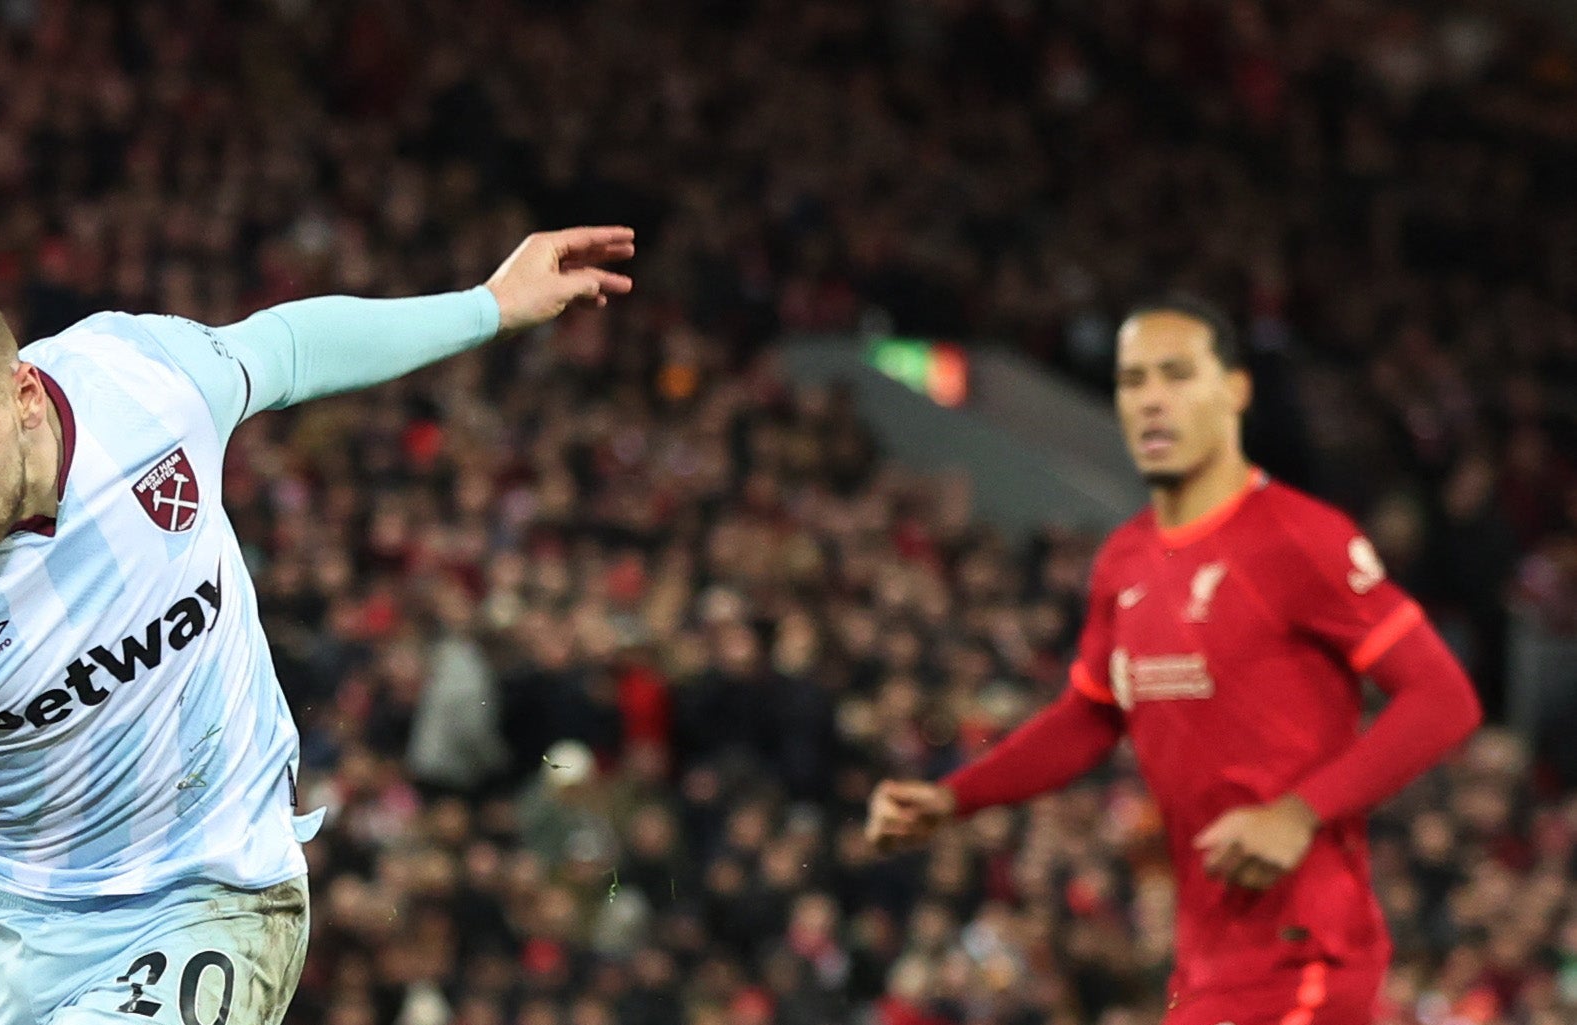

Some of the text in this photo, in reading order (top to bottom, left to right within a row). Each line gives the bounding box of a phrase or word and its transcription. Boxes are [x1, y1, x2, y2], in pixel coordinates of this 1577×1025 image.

[136, 453, 182, 493] WEST HAM
[150, 467, 176, 491] UNITED
